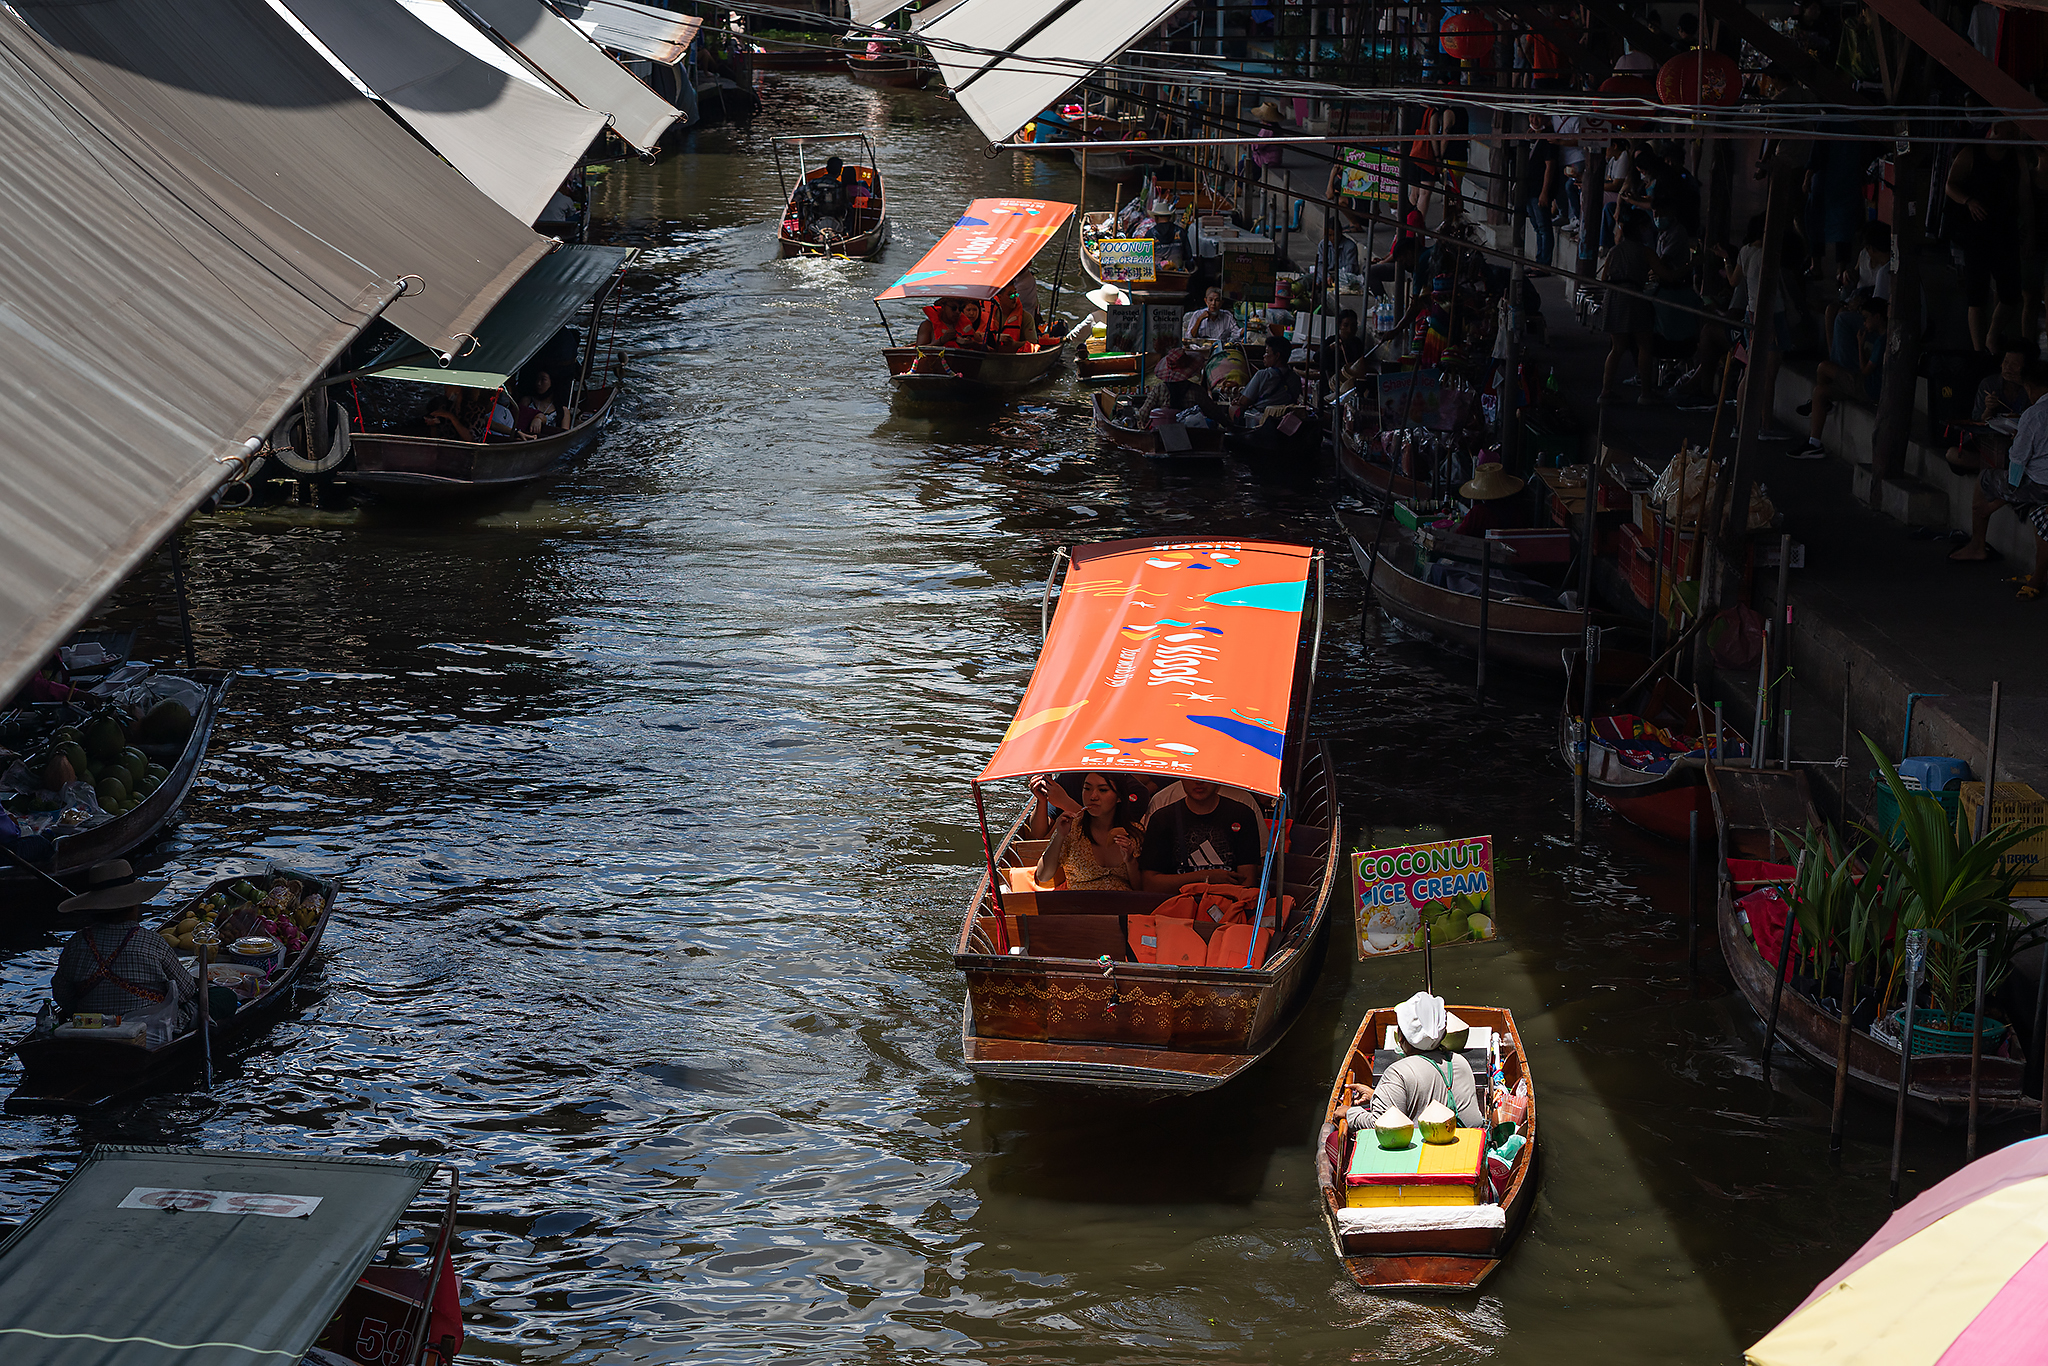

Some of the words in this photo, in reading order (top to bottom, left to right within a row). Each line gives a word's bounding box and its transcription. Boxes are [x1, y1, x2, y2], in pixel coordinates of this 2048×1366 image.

[1100, 242, 1153, 253] COCONUT
[1119, 255, 1153, 264] CREAM
[1151, 544, 1241, 552] klook
[1081, 756, 1193, 770] klook
[1360, 844, 1483, 882] COCONUT
[1371, 882, 1406, 907] ICE
[1413, 872, 1488, 900] CREAM
[356, 1316, 414, 1366] 59
